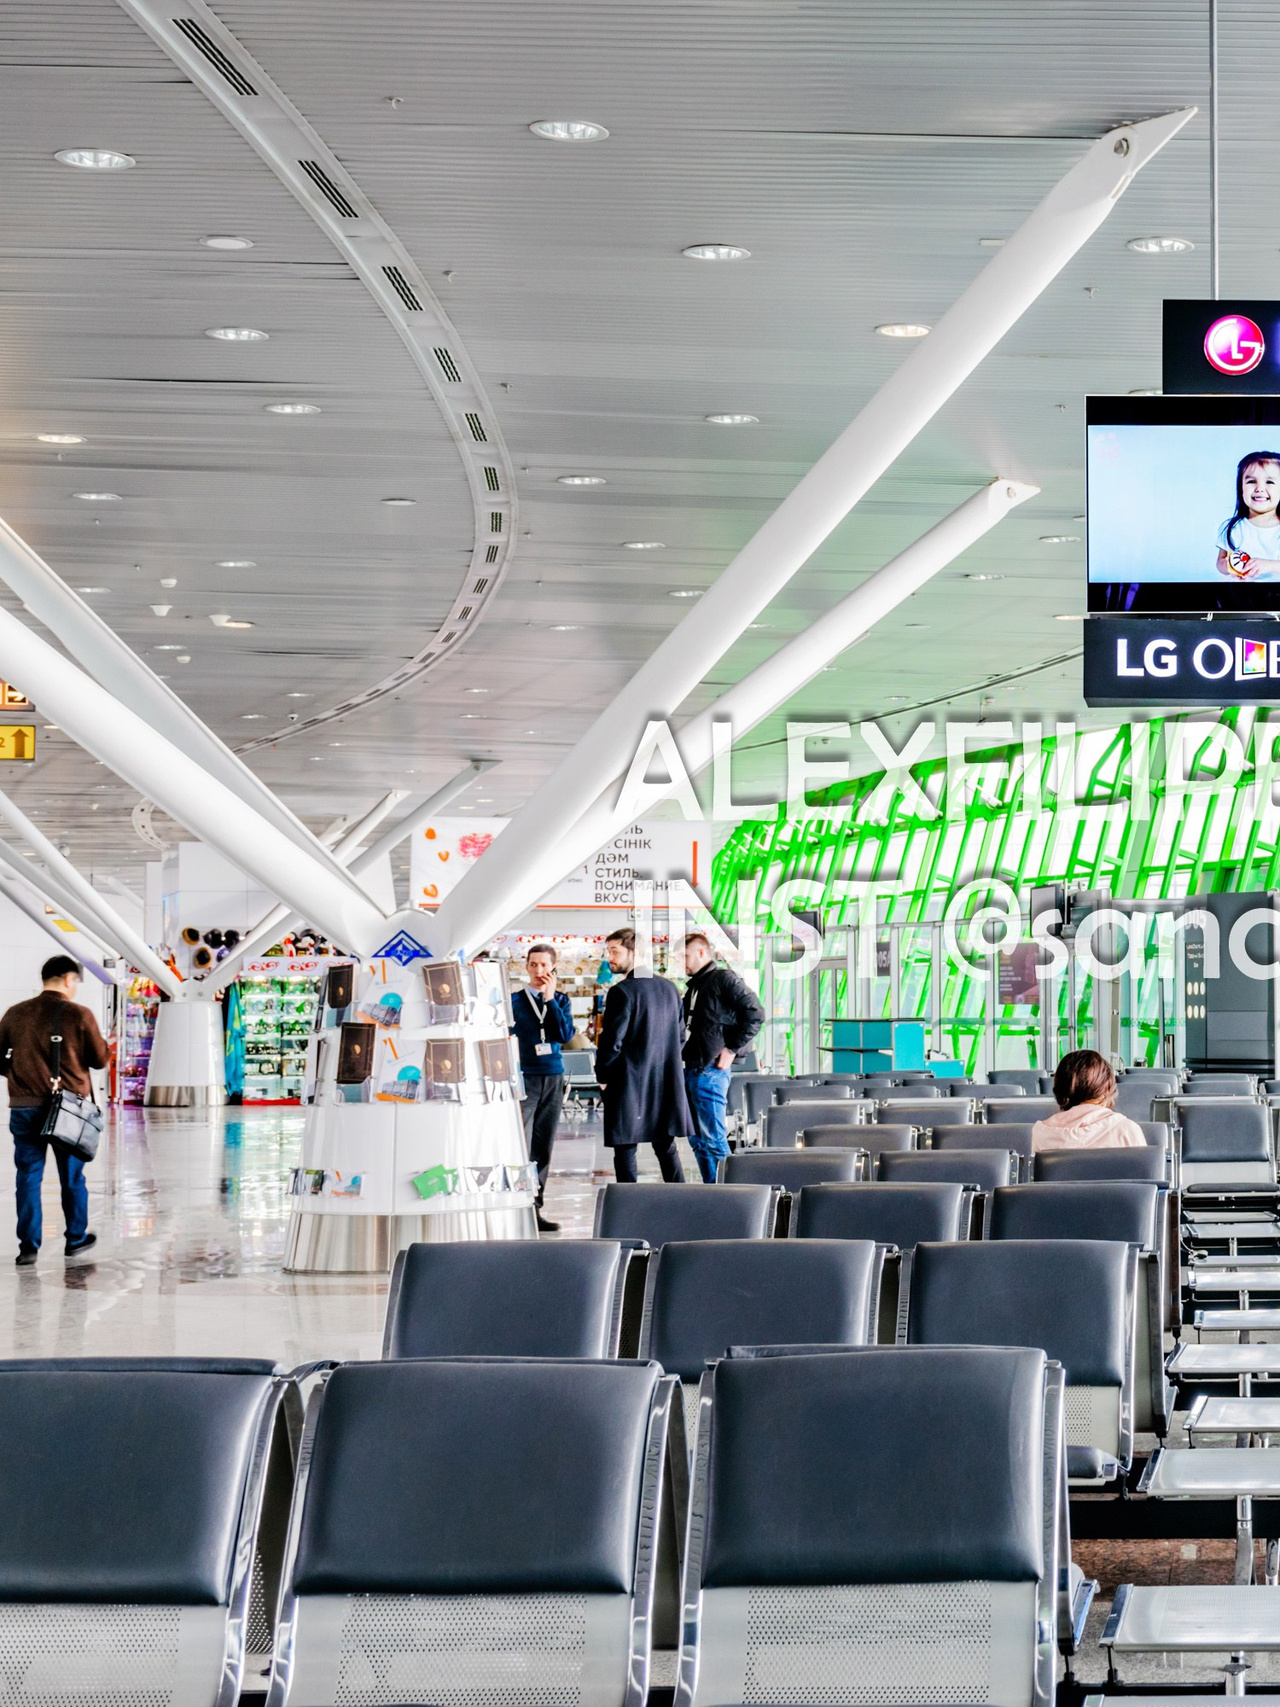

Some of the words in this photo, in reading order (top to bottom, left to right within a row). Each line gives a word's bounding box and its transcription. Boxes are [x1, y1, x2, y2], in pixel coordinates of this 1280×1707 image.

[1116, 638, 1177, 678] LG
[595, 853, 629, 865] ДӘМ
[595, 892, 633, 904] ВКУС.
